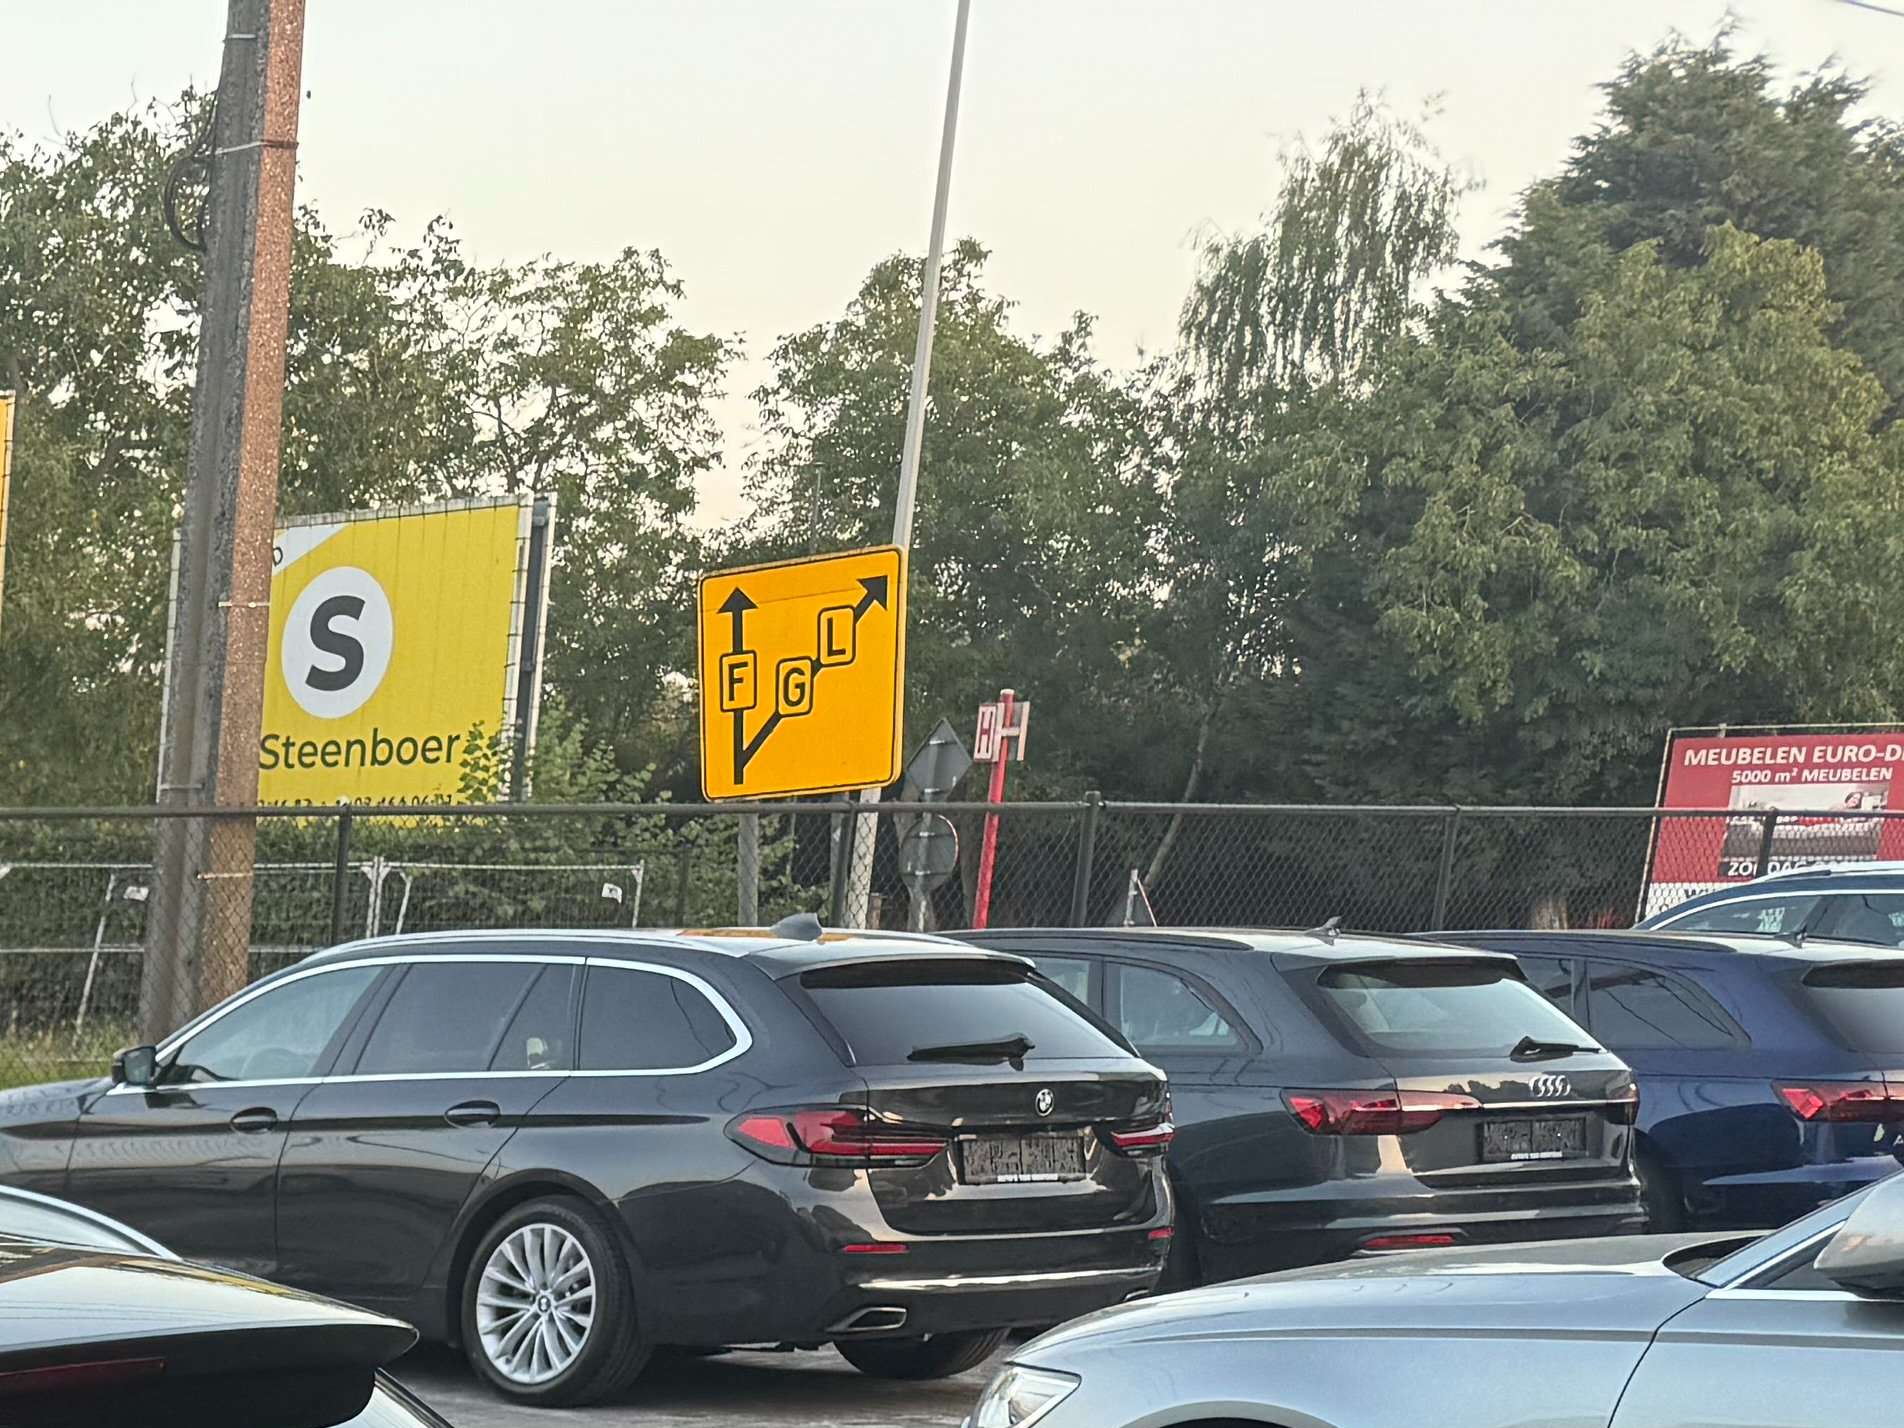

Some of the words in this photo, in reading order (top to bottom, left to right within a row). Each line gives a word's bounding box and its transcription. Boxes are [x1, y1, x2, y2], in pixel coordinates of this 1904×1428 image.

[827, 617, 847, 658] L
[728, 661, 749, 702] F
[783, 667, 806, 707] G
[1684, 746, 1806, 767] MEUBELEN
[1812, 743, 1904, 763] EURO-D
[1732, 770, 1771, 784] 5000
[1800, 767, 1893, 783] MEUBELEN
